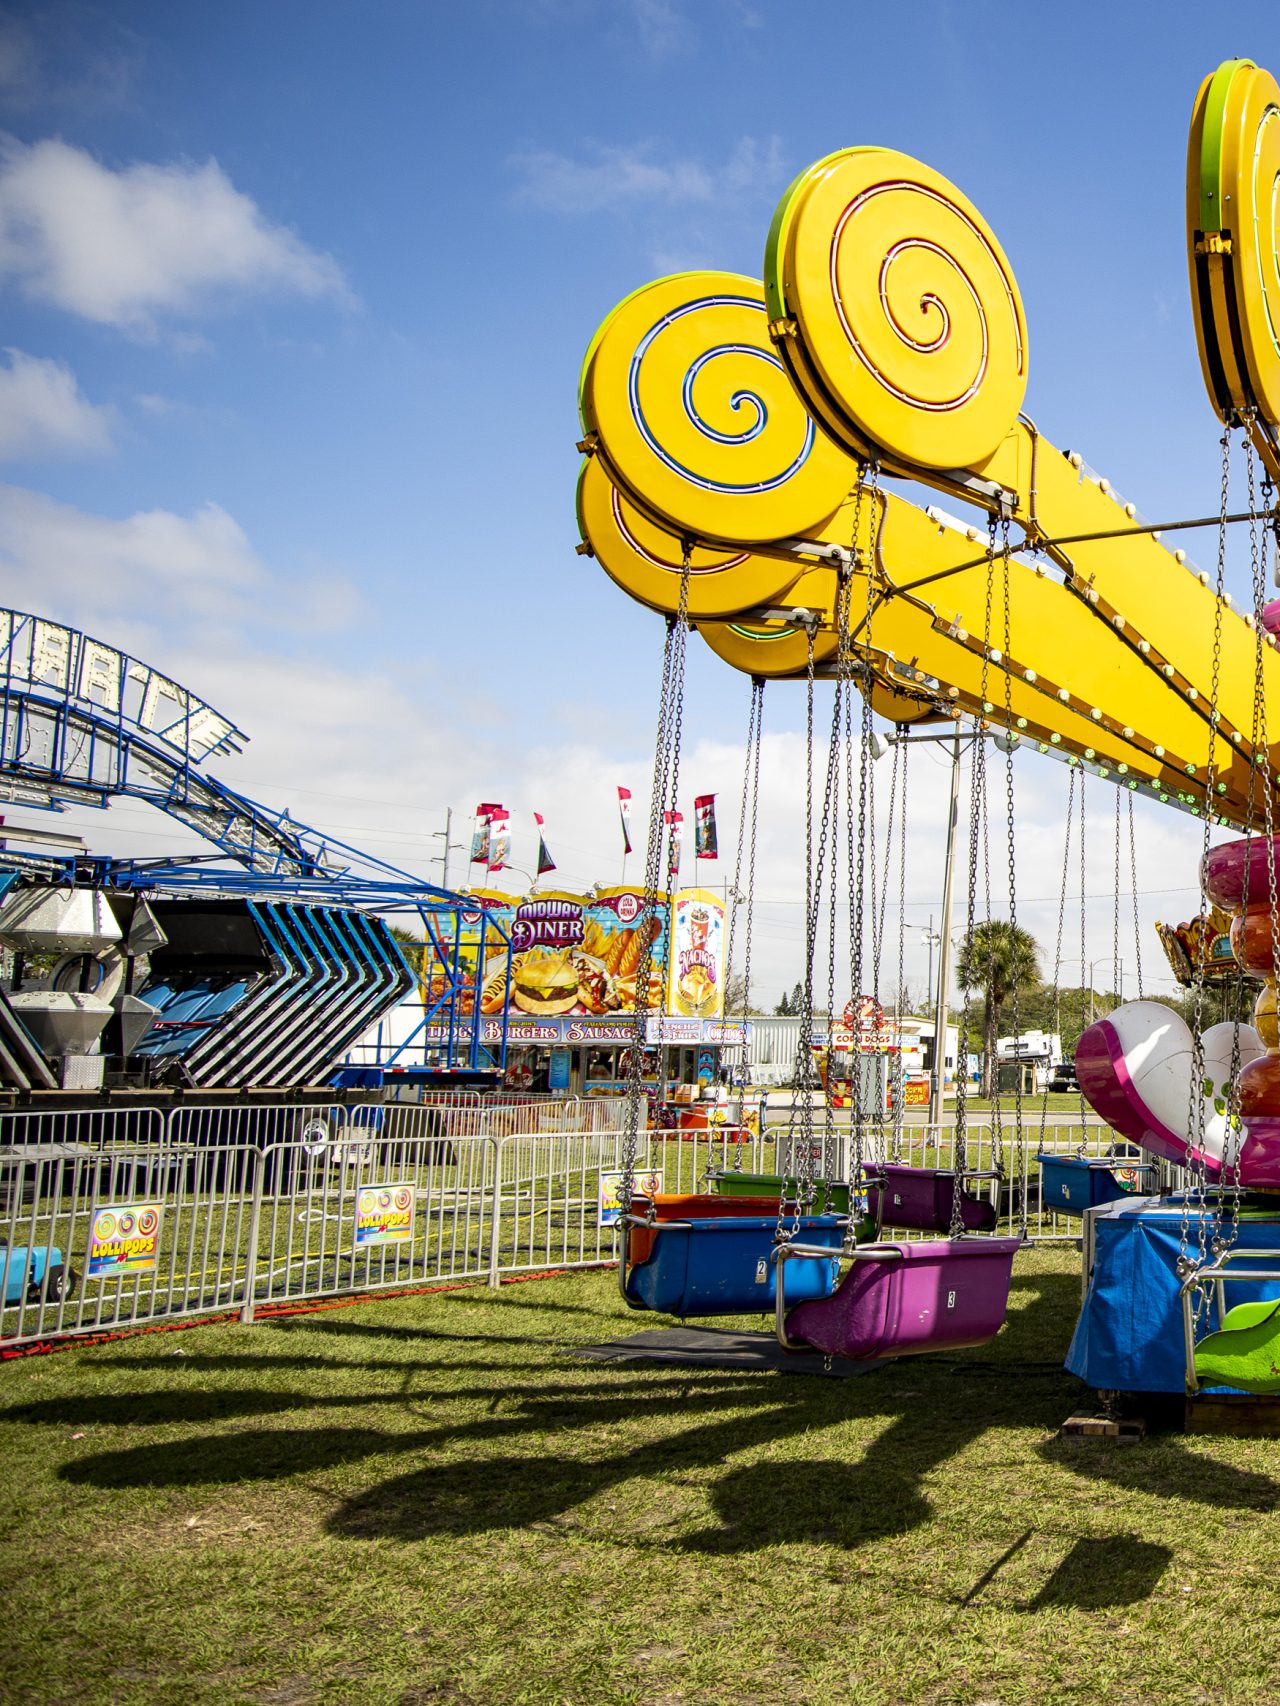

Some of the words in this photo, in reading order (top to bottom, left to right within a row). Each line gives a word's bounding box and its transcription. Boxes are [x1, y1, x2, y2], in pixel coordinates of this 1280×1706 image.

[519, 901, 580, 918] MIDWAY
[512, 920, 582, 950] DINER
[679, 949, 716, 983] NACHOS
[484, 1020, 558, 1040] BURGERS
[358, 1212, 410, 1229] LOLLIPOPS
[91, 1237, 155, 1258] LOLLIPOPS
[758, 1262, 765, 1274] 2
